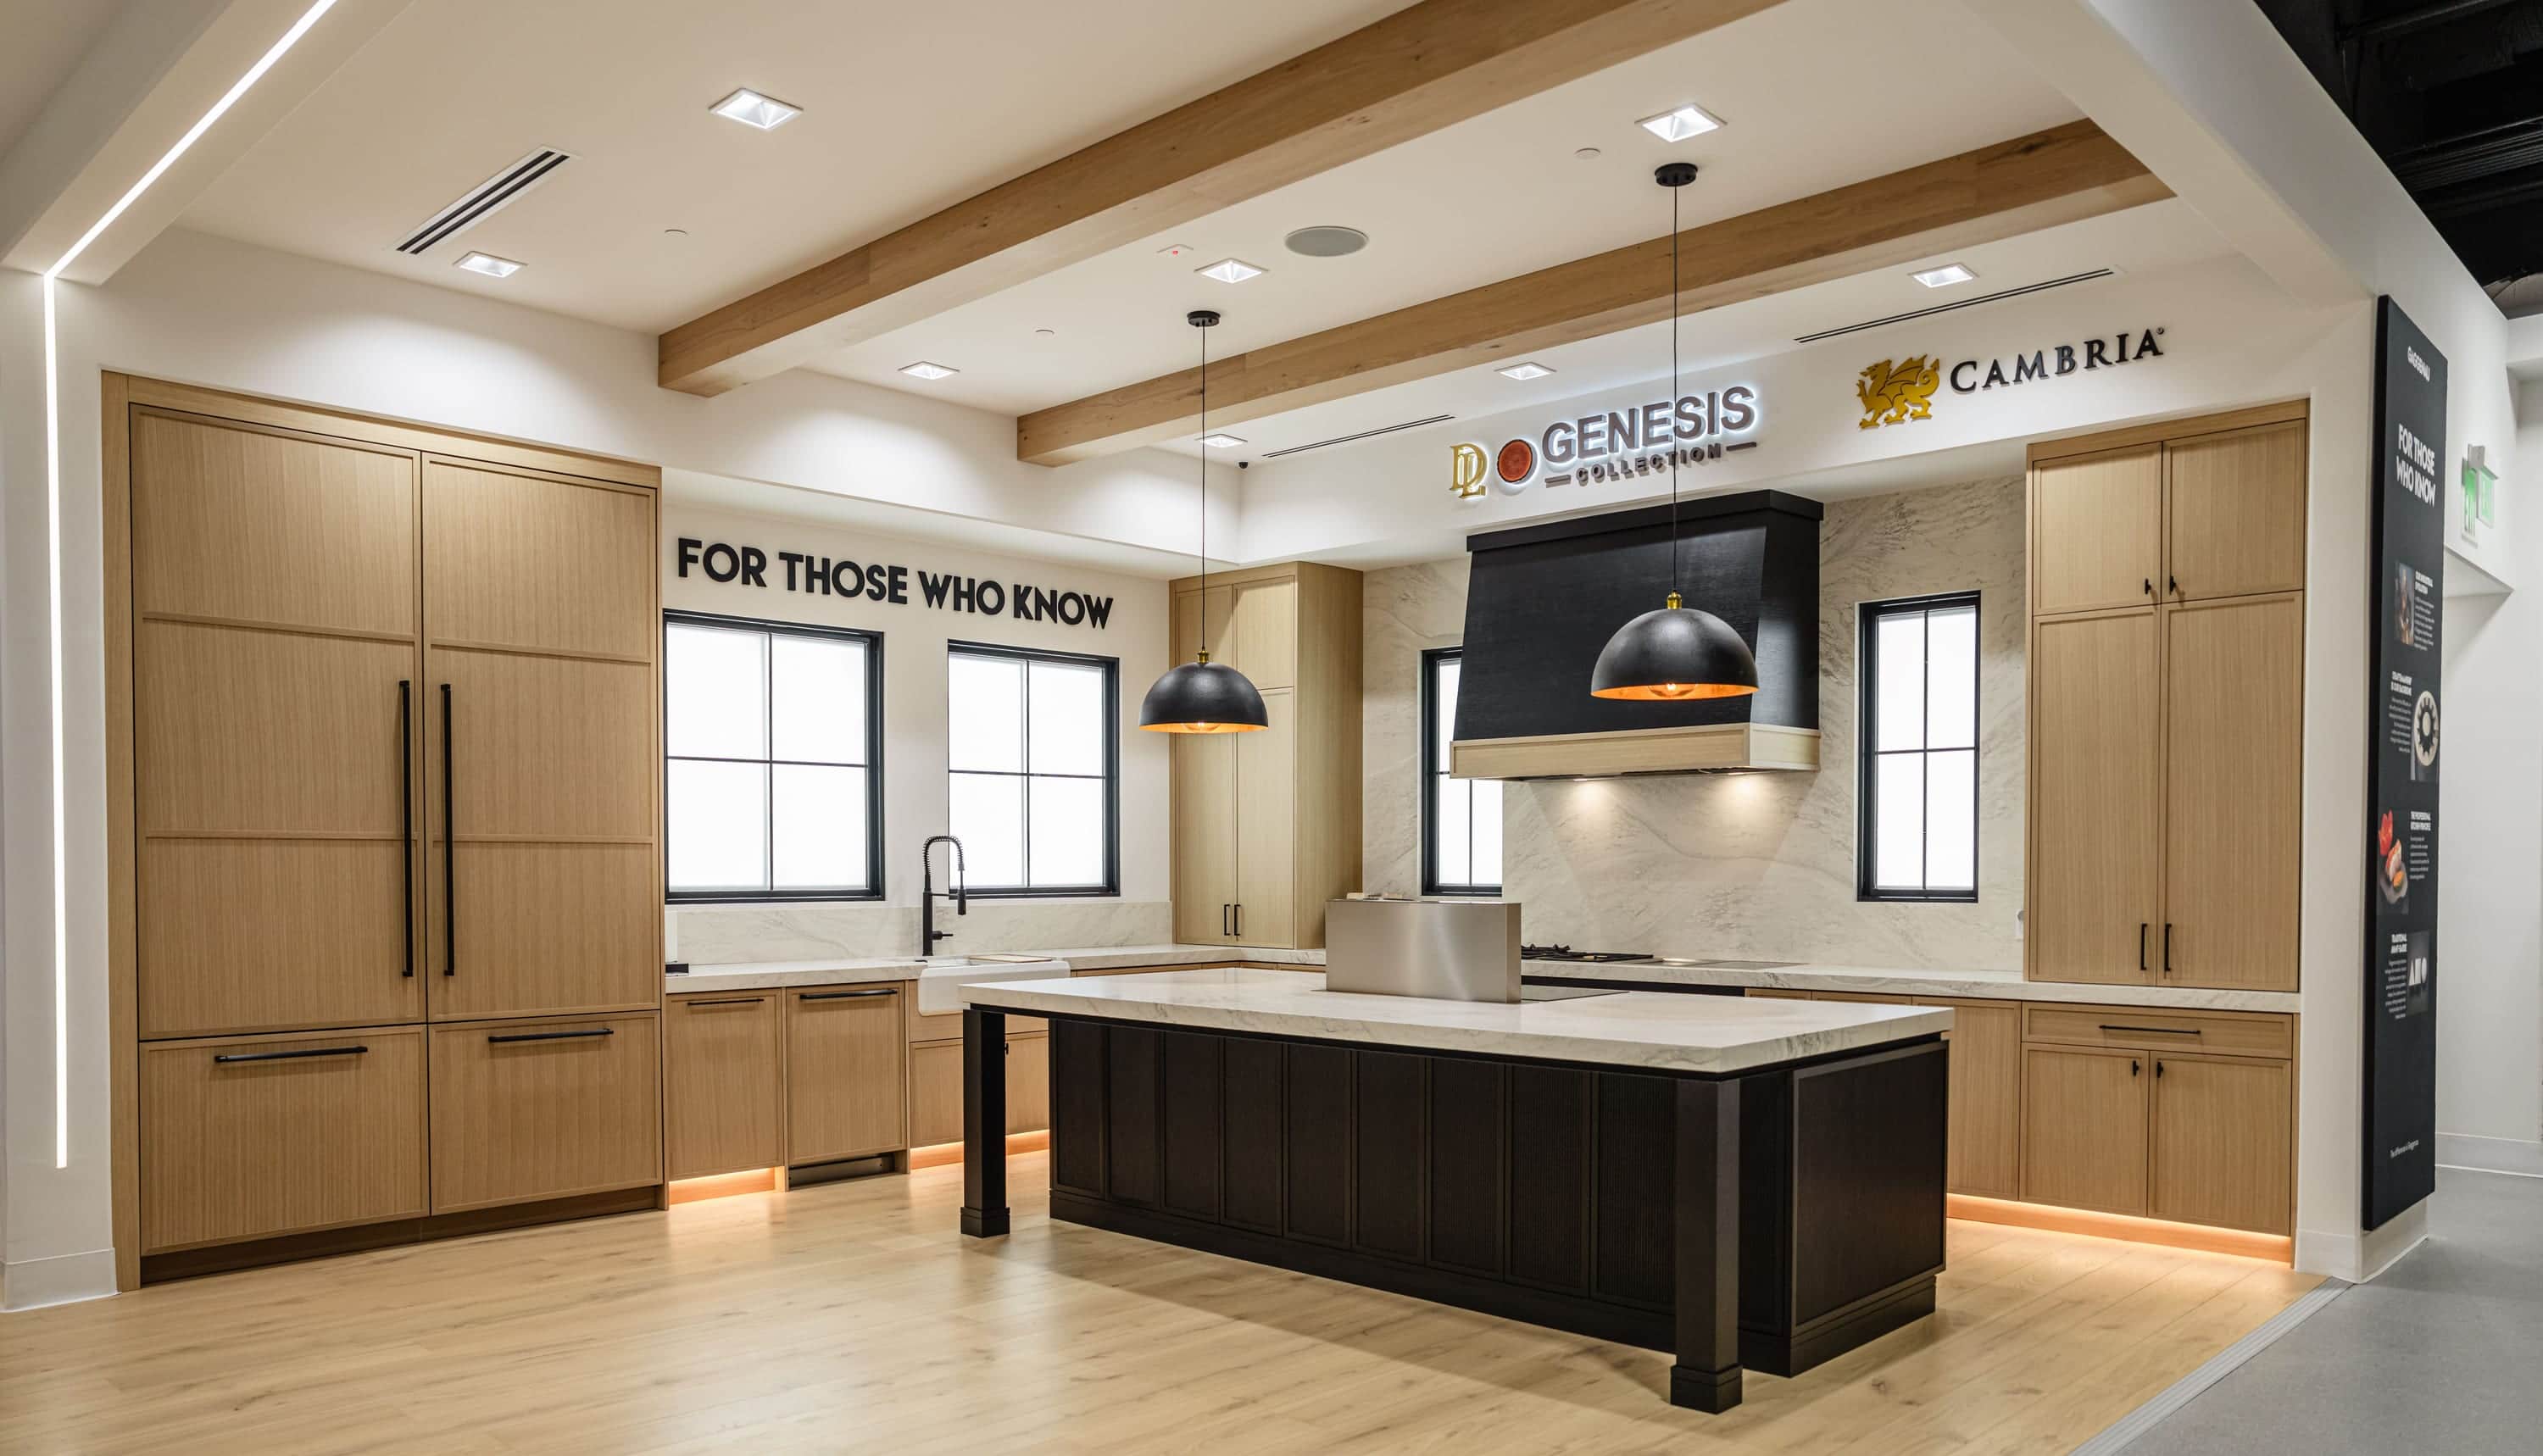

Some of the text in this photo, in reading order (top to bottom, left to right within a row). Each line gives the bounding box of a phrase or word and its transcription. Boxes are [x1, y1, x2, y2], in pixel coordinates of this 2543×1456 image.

[1542, 386, 1755, 464] GENESIS
[2398, 424, 2435, 476] FOR THOSE
[1576, 442, 1722, 486] COLLECTION
[2396, 455, 2414, 492] WHO
[2414, 470, 2436, 507] KNOW
[678, 538, 1113, 630] FOR THOSE WHO KNOW
